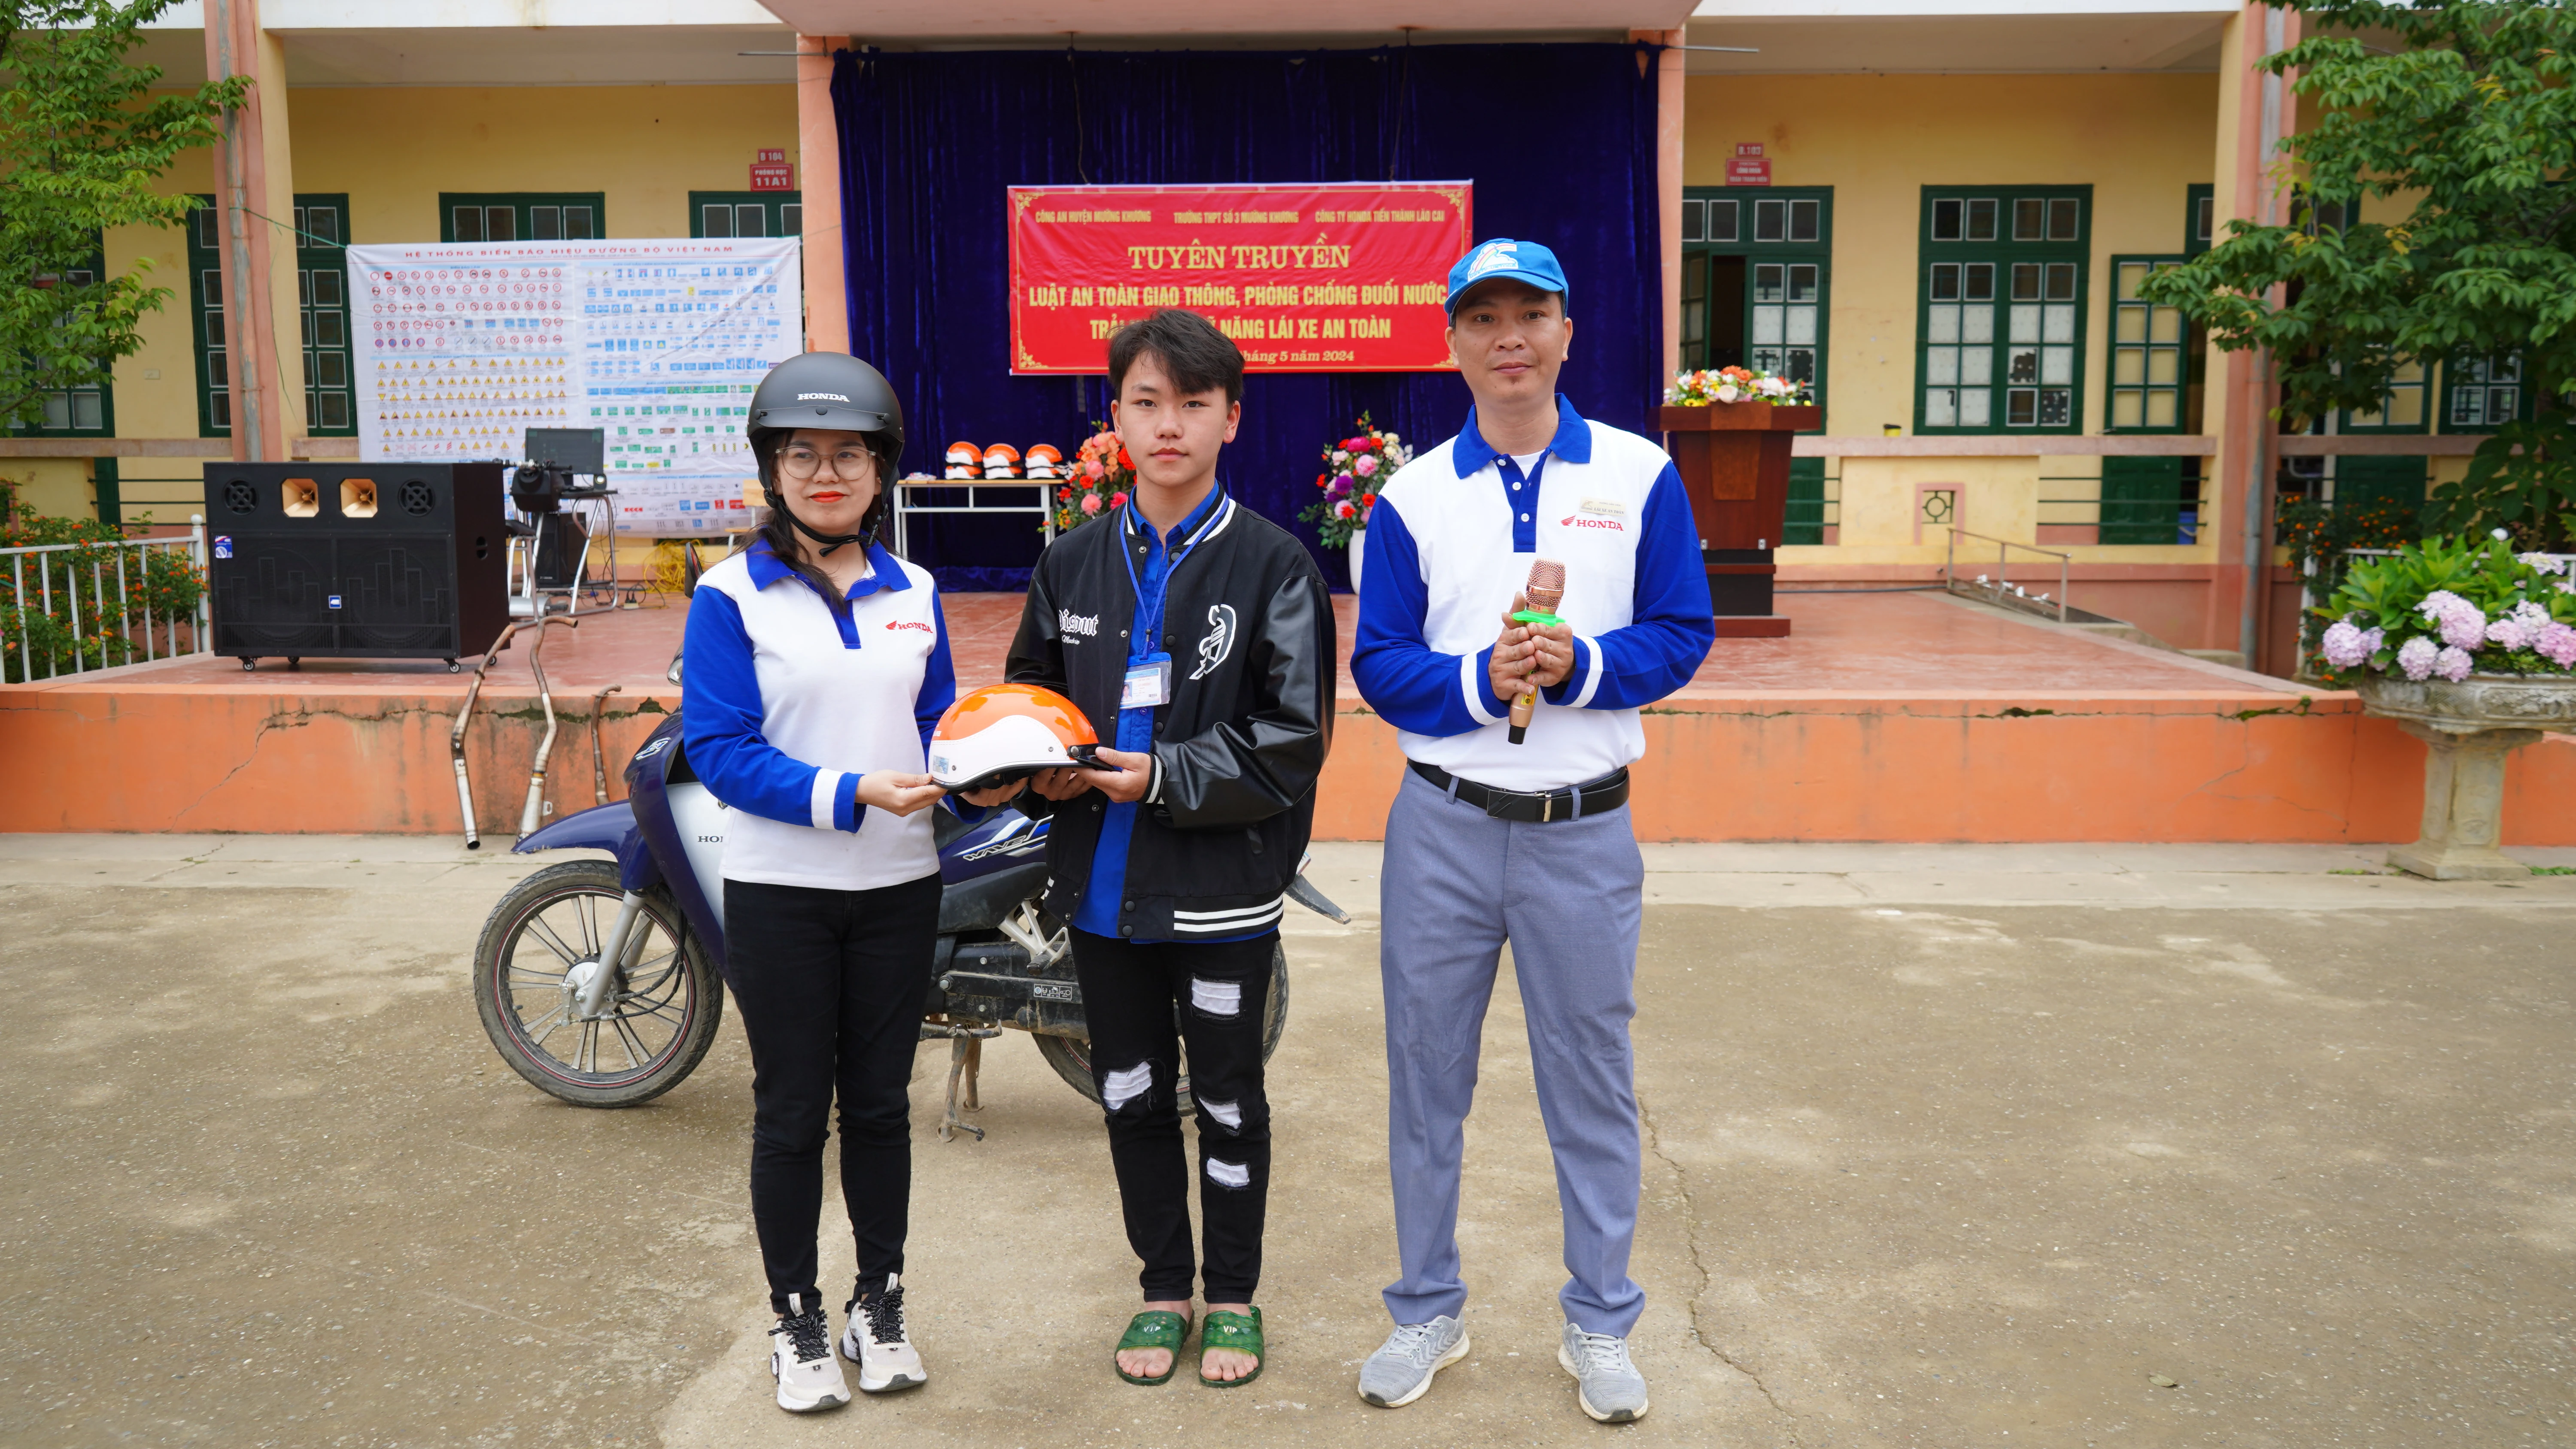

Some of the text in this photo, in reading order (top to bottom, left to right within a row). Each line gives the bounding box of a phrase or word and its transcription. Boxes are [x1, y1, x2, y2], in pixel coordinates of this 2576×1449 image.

[760, 152, 783, 161] B 104
[755, 176, 787, 186] 11A1
[1035, 209, 1055, 223] CÔNG
[1057, 211, 1067, 223] AN
[1068, 209, 1093, 225] HUYỆN
[1174, 209, 1202, 224] TRƯỜNG
[1203, 212, 1221, 224] THPT
[1223, 208, 1233, 224] SỐ
[1234, 212, 1240, 224] 3
[1315, 207, 1445, 223] CÔNG TY HONDA TIẾN THÀNH LÀO CAI
[551, 247, 582, 255] HIỆU
[644, 246, 660, 255] BỘ
[1127, 232, 1352, 270] TUYÊN TRUYỀN
[1029, 279, 1447, 311] LUẬT AN TOÀN GIAO THÔNG, PHÒNG CHỐNG ĐUỐI NƯỚC
[1220, 315, 1265, 339] NĂNG
[1269, 315, 1294, 339] LÁI
[1297, 319, 1318, 339] XE
[1322, 318, 1346, 338] AN
[1349, 315, 1391, 338] TOÀN
[1240, 350, 1355, 364] háng 5 năm 2024
[797, 393, 851, 403] HONDA
[1576, 519, 1624, 531] HONDA
[897, 622, 933, 634] HONDA
[963, 834, 1027, 861] WAVE
[1223, 1325, 1238, 1334] VIP
